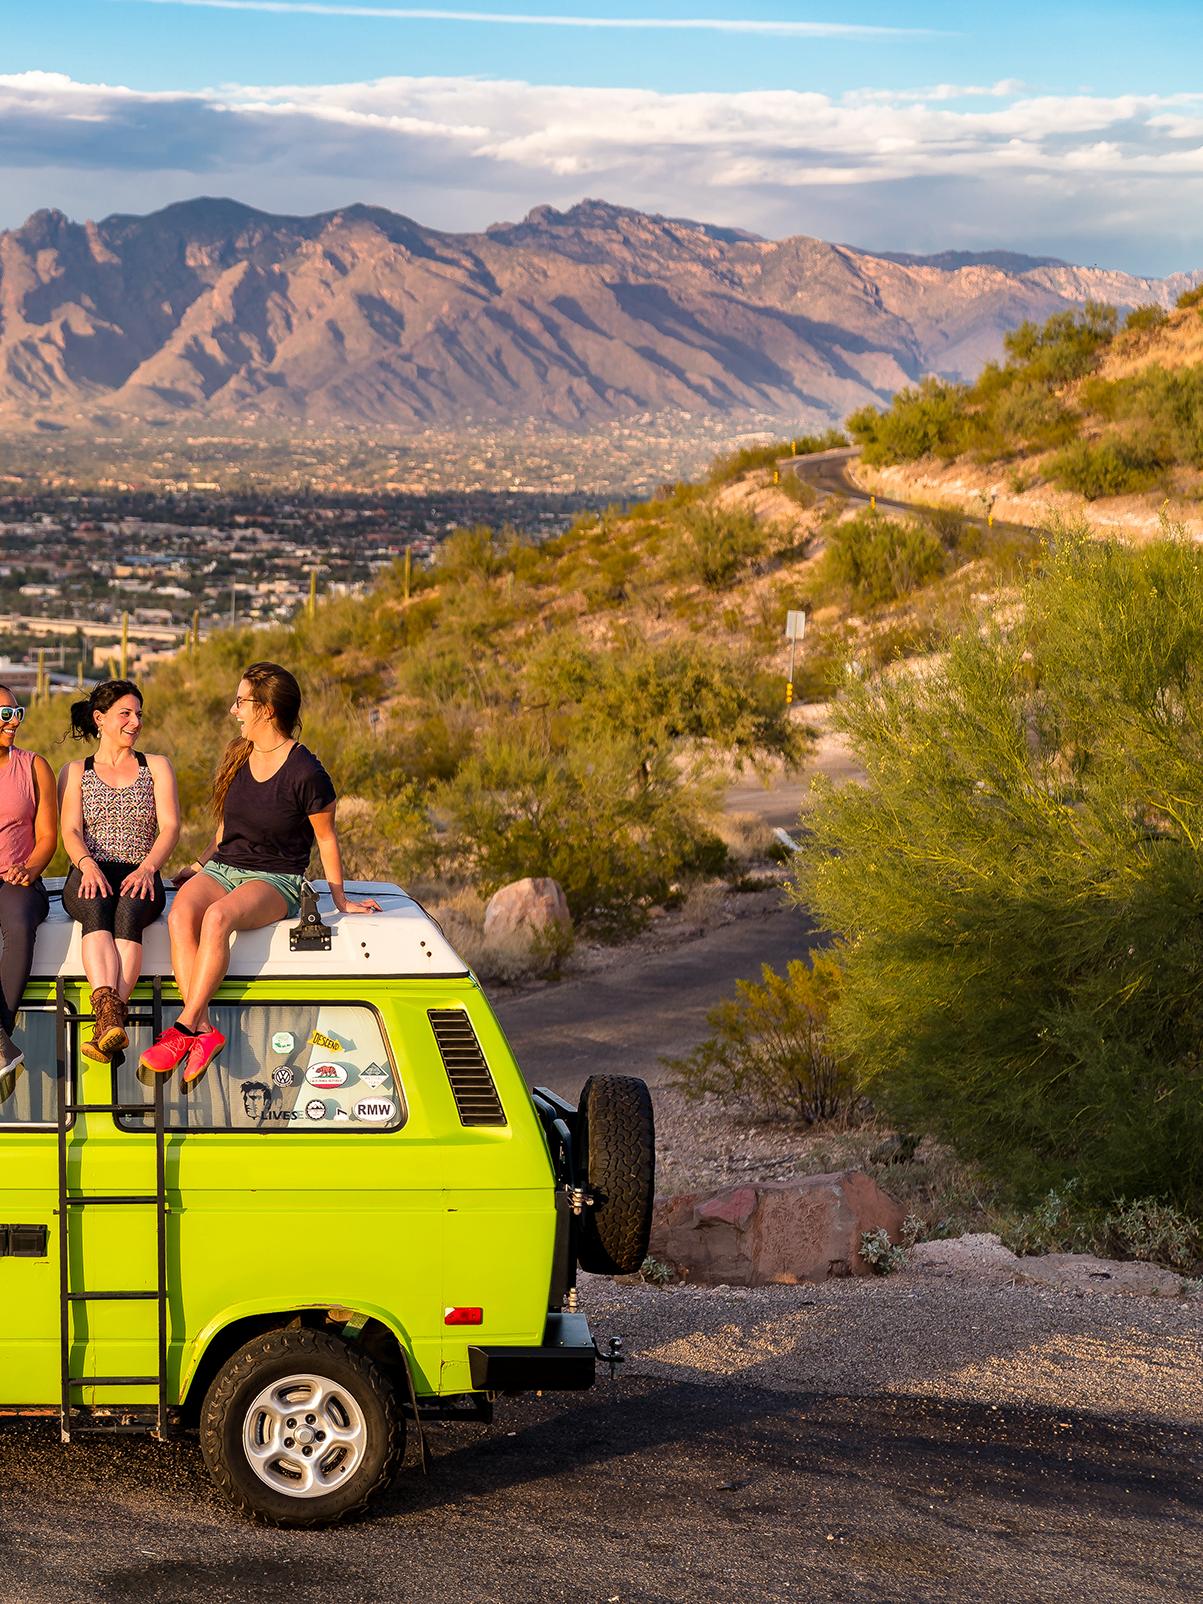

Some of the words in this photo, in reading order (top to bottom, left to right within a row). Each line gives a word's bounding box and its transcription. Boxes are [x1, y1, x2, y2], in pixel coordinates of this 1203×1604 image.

[313, 1032, 340, 1051] DESCEND
[261, 1110, 298, 1121] LIVES
[357, 1104, 391, 1116] RMW
